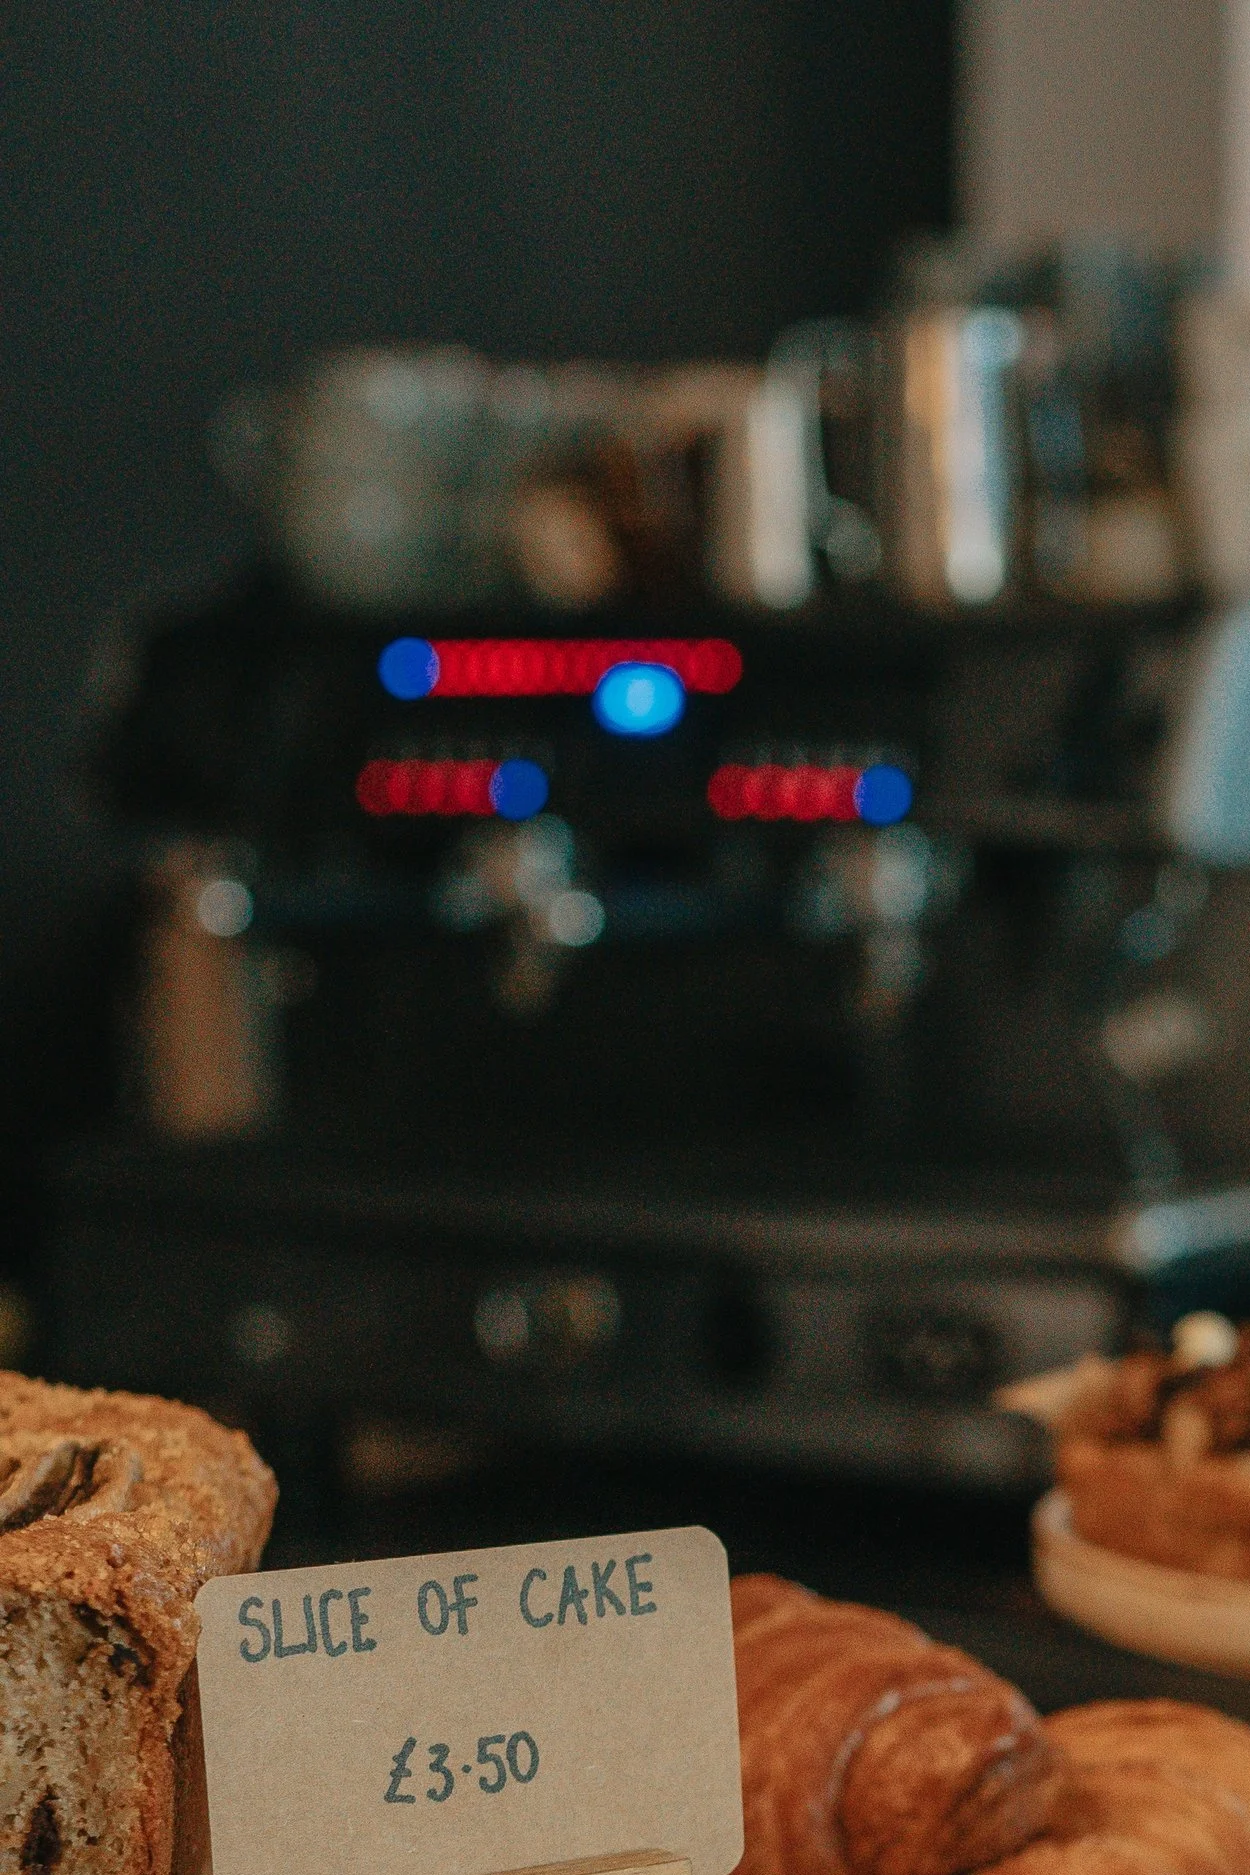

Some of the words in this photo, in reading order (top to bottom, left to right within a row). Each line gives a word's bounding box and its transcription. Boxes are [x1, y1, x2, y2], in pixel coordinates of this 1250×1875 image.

[238, 1586, 377, 1664] SLICE
[416, 1573, 479, 1636] OF
[519, 1552, 658, 1629] CAKE
[383, 1730, 541, 1805] £3.50
